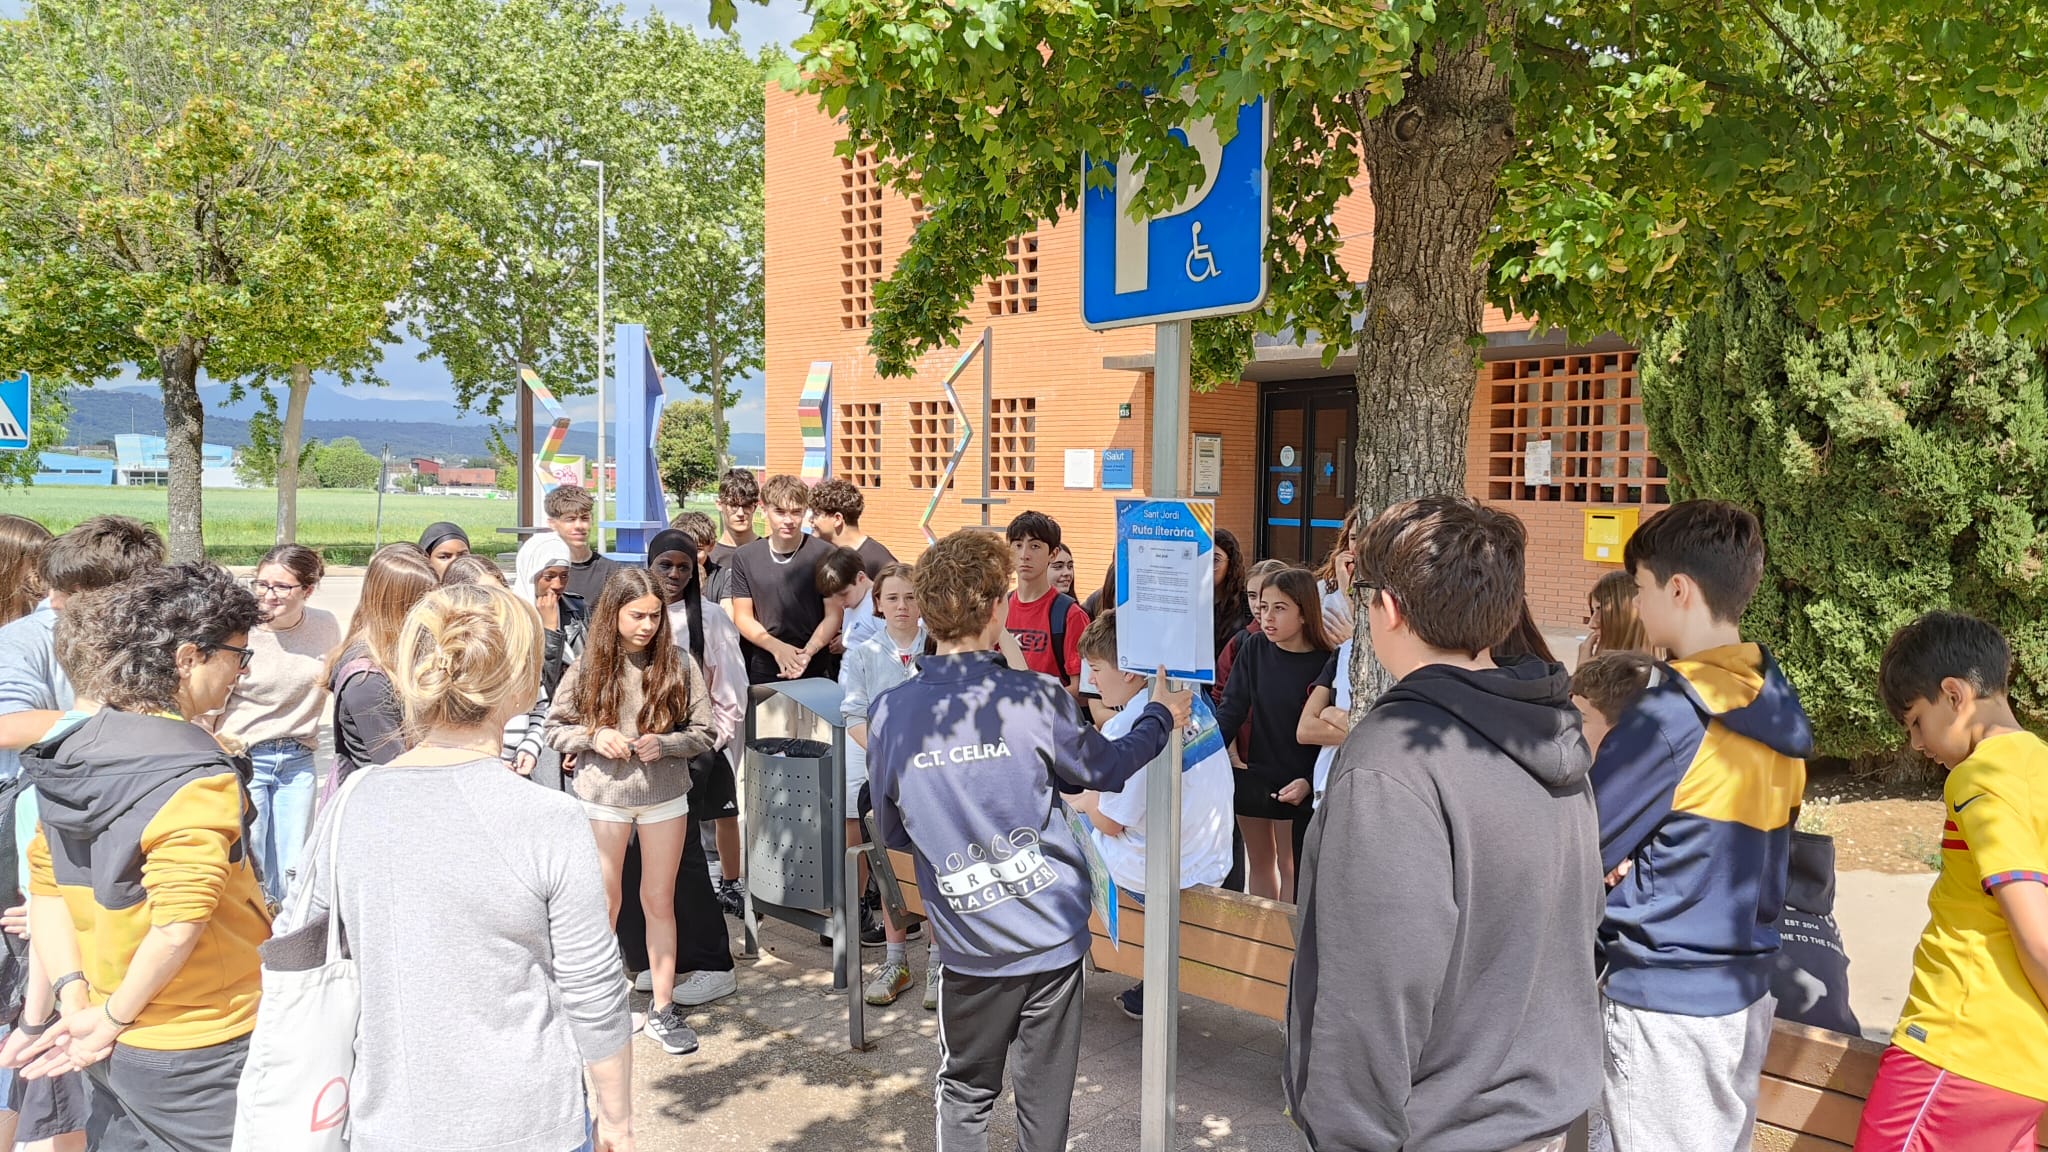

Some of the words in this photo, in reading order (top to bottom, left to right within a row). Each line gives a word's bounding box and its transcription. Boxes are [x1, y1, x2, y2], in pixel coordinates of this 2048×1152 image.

[1143, 509, 1159, 519] Sant
[1160, 511, 1180, 520] Jordi
[1132, 524, 1153, 535] Ruta
[1155, 525, 1194, 538] literària
[913, 750, 945, 769] C.T.
[950, 737, 1011, 763] CELRÀ
[942, 850, 1039, 893] GROUP
[948, 868, 1056, 911] MAGISTER
[1780, 933, 1795, 941] ME
[1796, 934, 1809, 942] TO
[1809, 936, 1826, 946] THE
